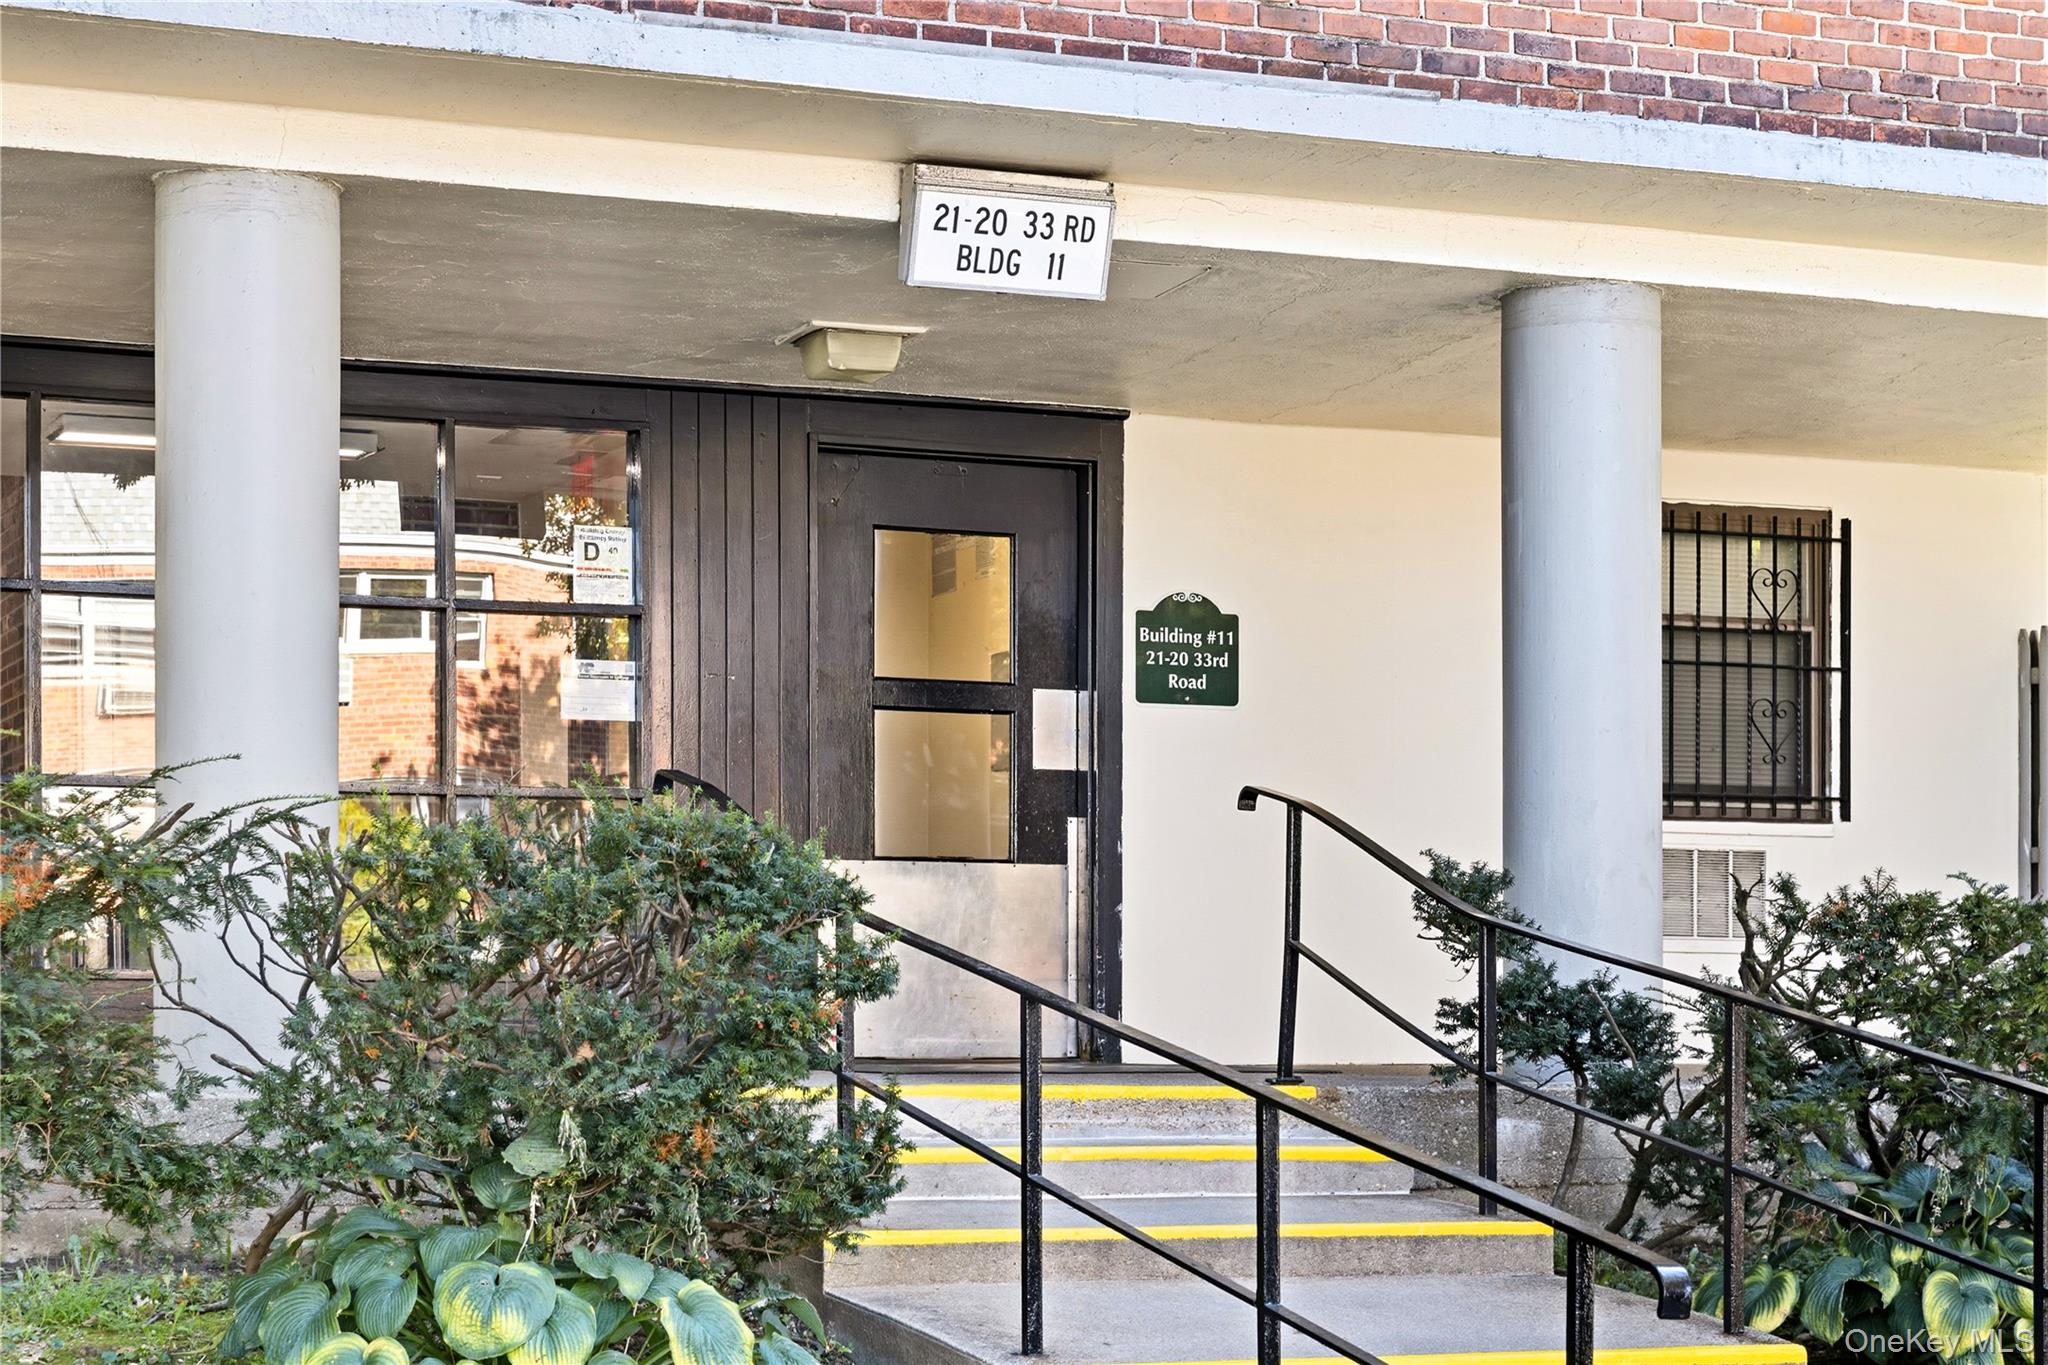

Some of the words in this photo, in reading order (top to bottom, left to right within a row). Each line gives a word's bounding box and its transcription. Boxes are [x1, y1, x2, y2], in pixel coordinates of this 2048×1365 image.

[933, 203, 1008, 236] 21-20
[1023, 210, 1055, 240] 33
[1064, 215, 1096, 243] RD
[956, 244, 1022, 276] BLDG
[1047, 252, 1066, 280] 11
[583, 541, 600, 561] D
[1139, 627, 1202, 648] Building
[1206, 630, 1234, 646] #11
[1146, 650, 1189, 667] 21-20
[1193, 652, 1229, 668] 33rd
[1168, 673, 1207, 690] Road
